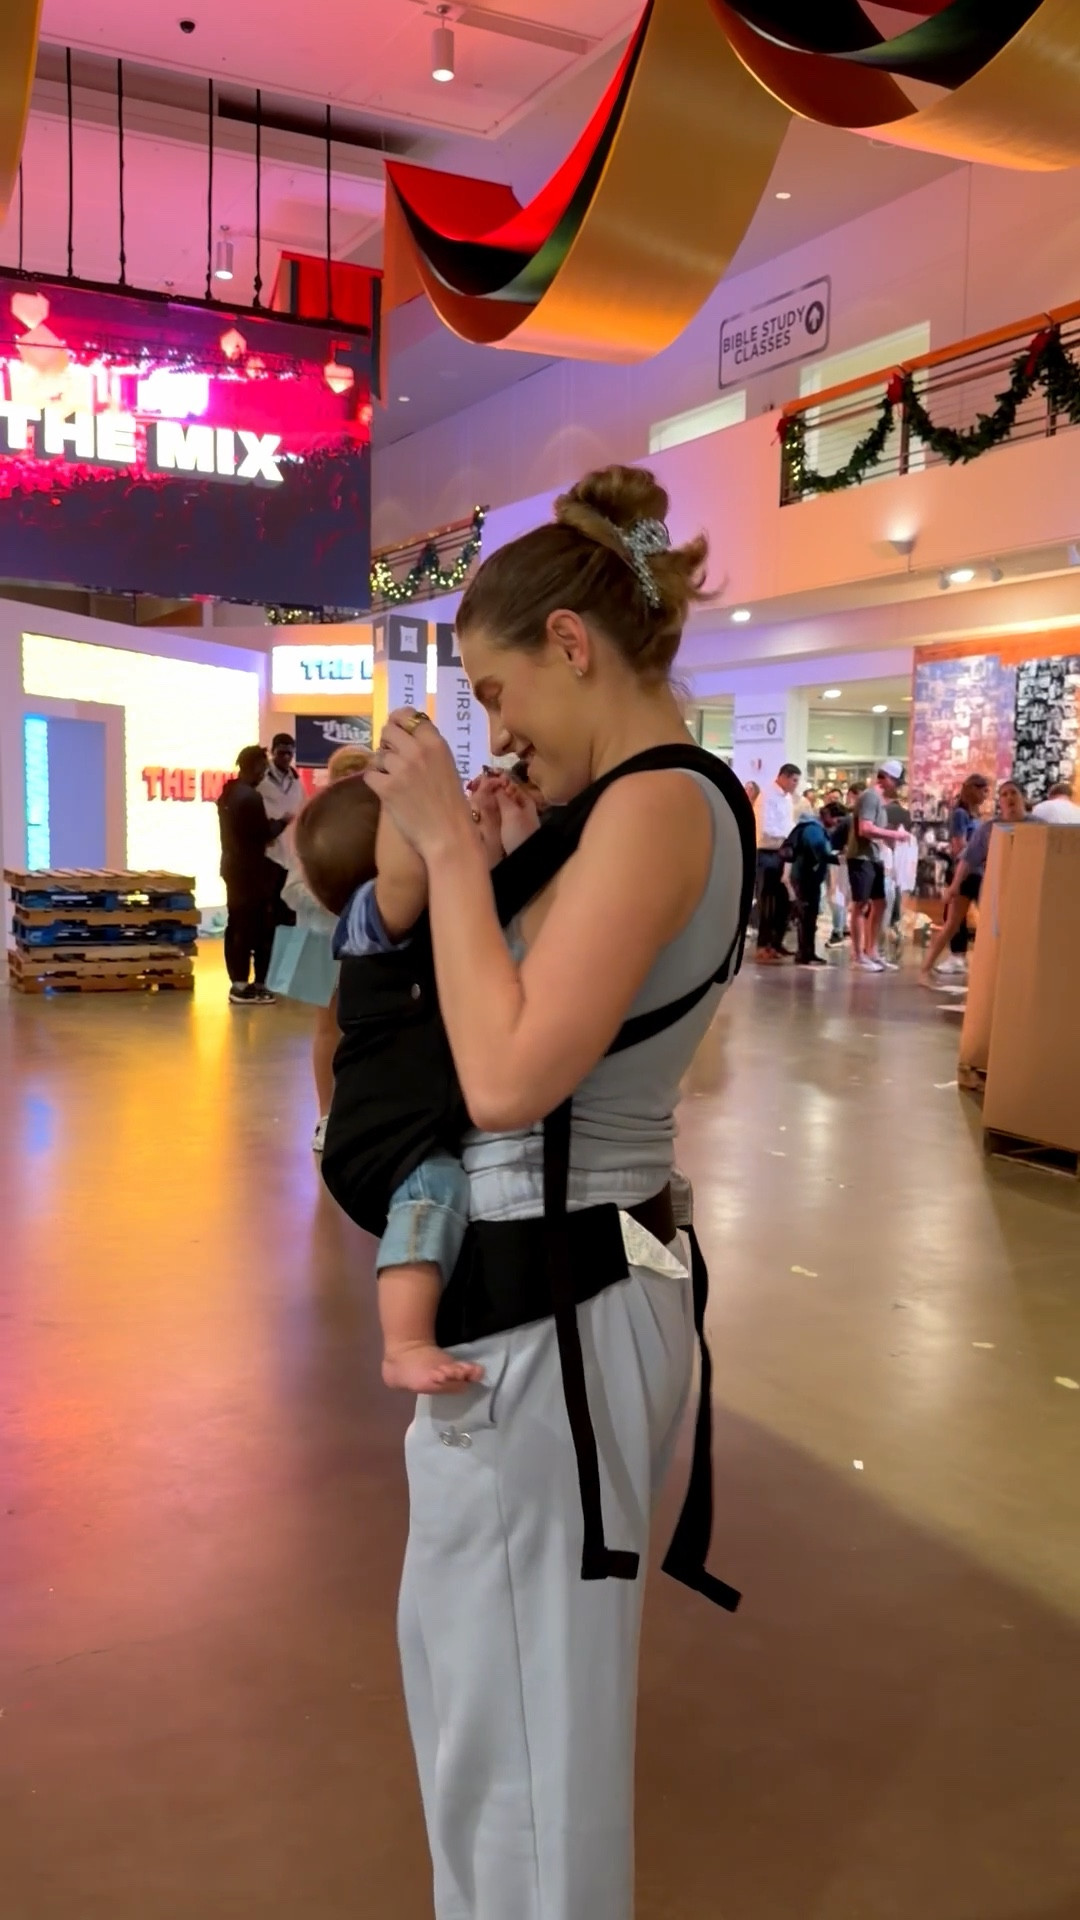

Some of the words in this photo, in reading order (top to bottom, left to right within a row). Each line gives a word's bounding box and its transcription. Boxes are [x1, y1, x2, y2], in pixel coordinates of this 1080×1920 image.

[723, 325, 758, 354] BIBLE
[762, 305, 806, 338] STUDY
[734, 329, 792, 365] CLASSES
[0, 400, 137, 467] THE
[150, 418, 285, 487] MIX
[300, 658, 354, 680] THE
[456, 678, 471, 735] FIRST
[142, 766, 196, 802] THE
